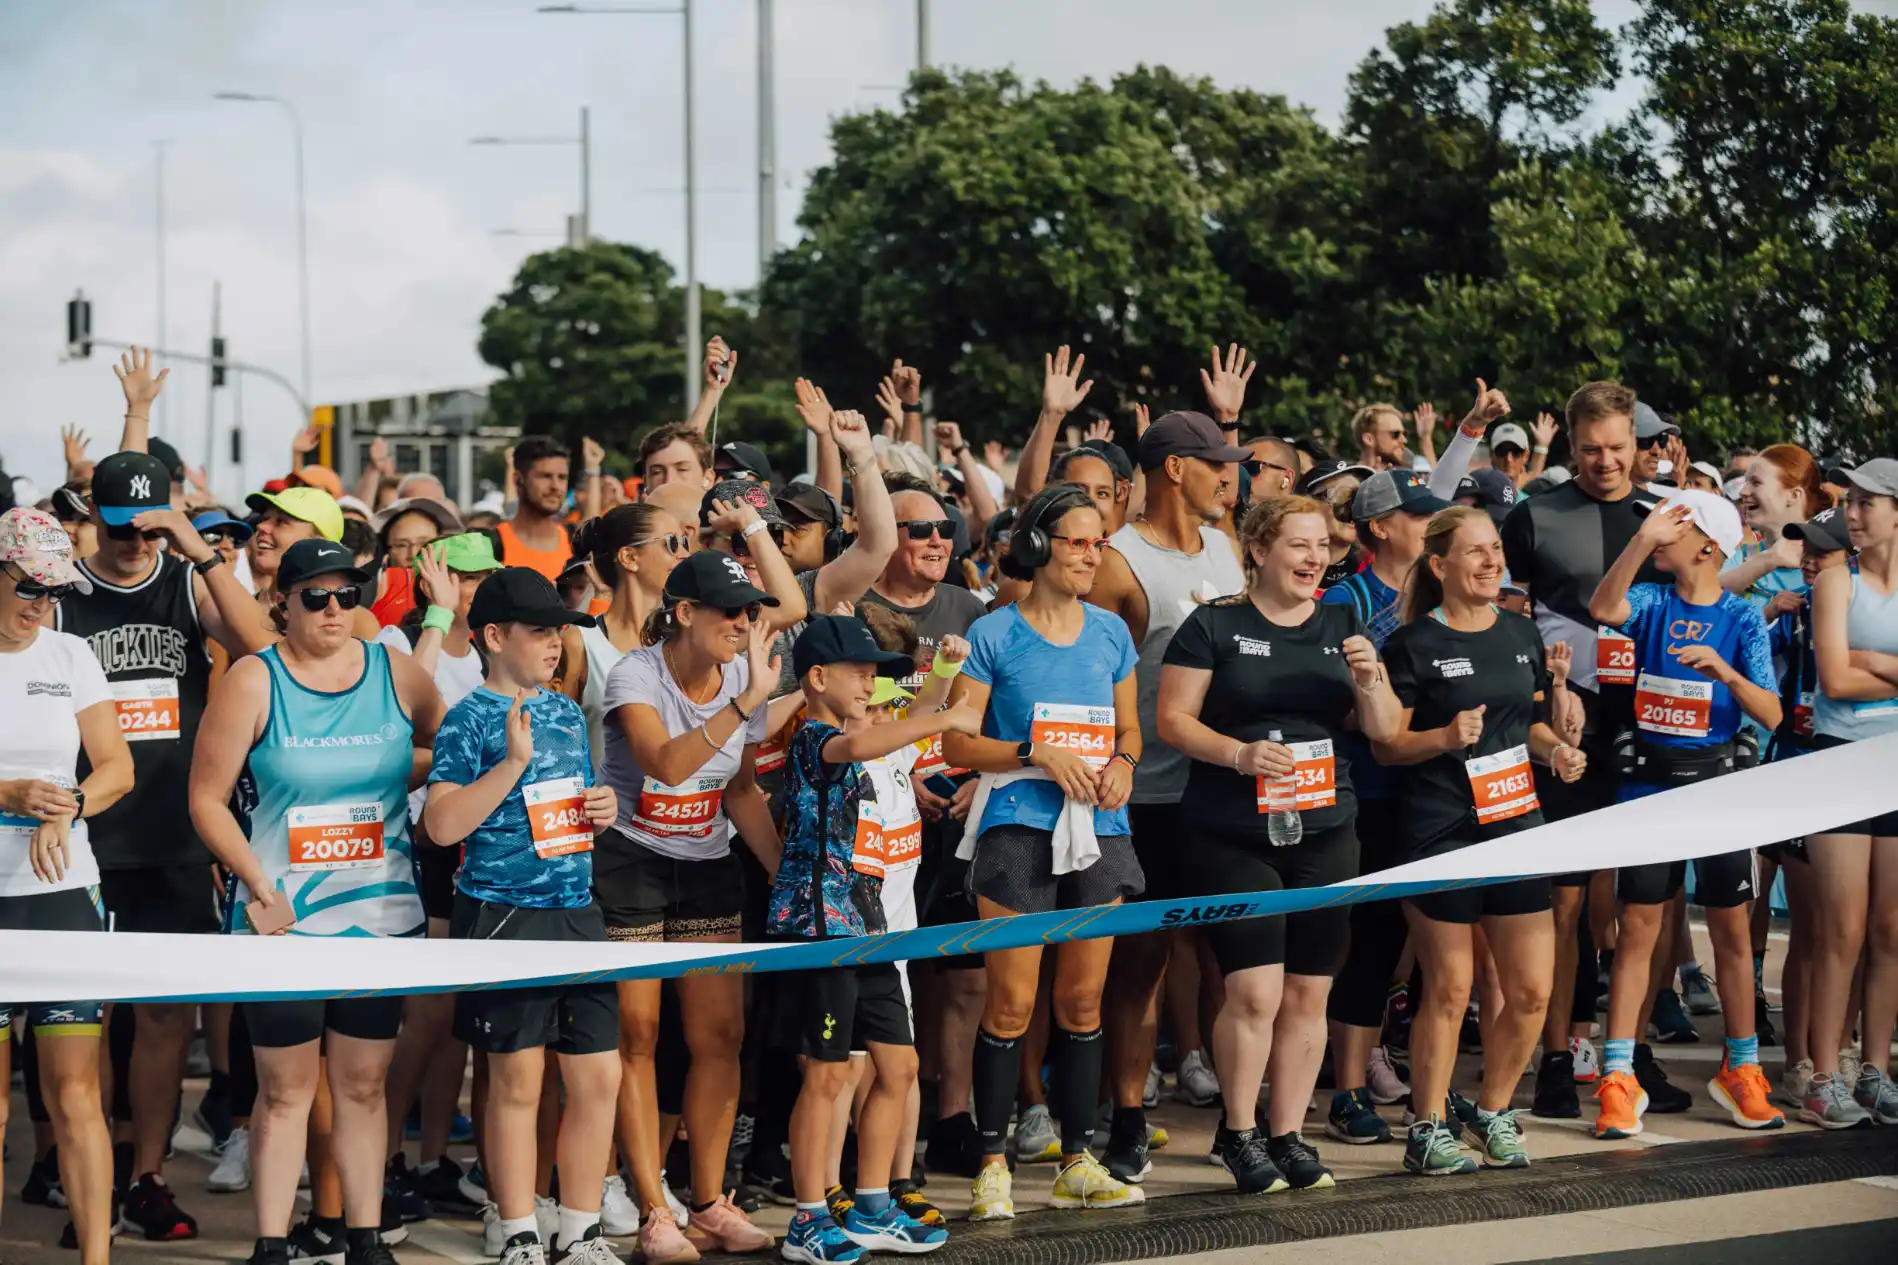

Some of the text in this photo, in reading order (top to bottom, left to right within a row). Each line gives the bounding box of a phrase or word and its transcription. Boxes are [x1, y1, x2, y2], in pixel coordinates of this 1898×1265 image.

[1669, 620, 1713, 641] CR7
[1090, 716, 1111, 725] BAYS
[1641, 704, 1697, 726] 20165
[284, 733, 383, 748] BLACKMORES
[1043, 731, 1105, 751] 22564
[349, 805, 377, 814] ROUND
[352, 813, 377, 823] BAYS
[651, 800, 710, 819] 24521
[543, 807, 591, 832] 2484
[322, 827, 354, 837] LOZZY
[302, 837, 375, 860] 20079
[1161, 903, 1249, 924] BAYS
